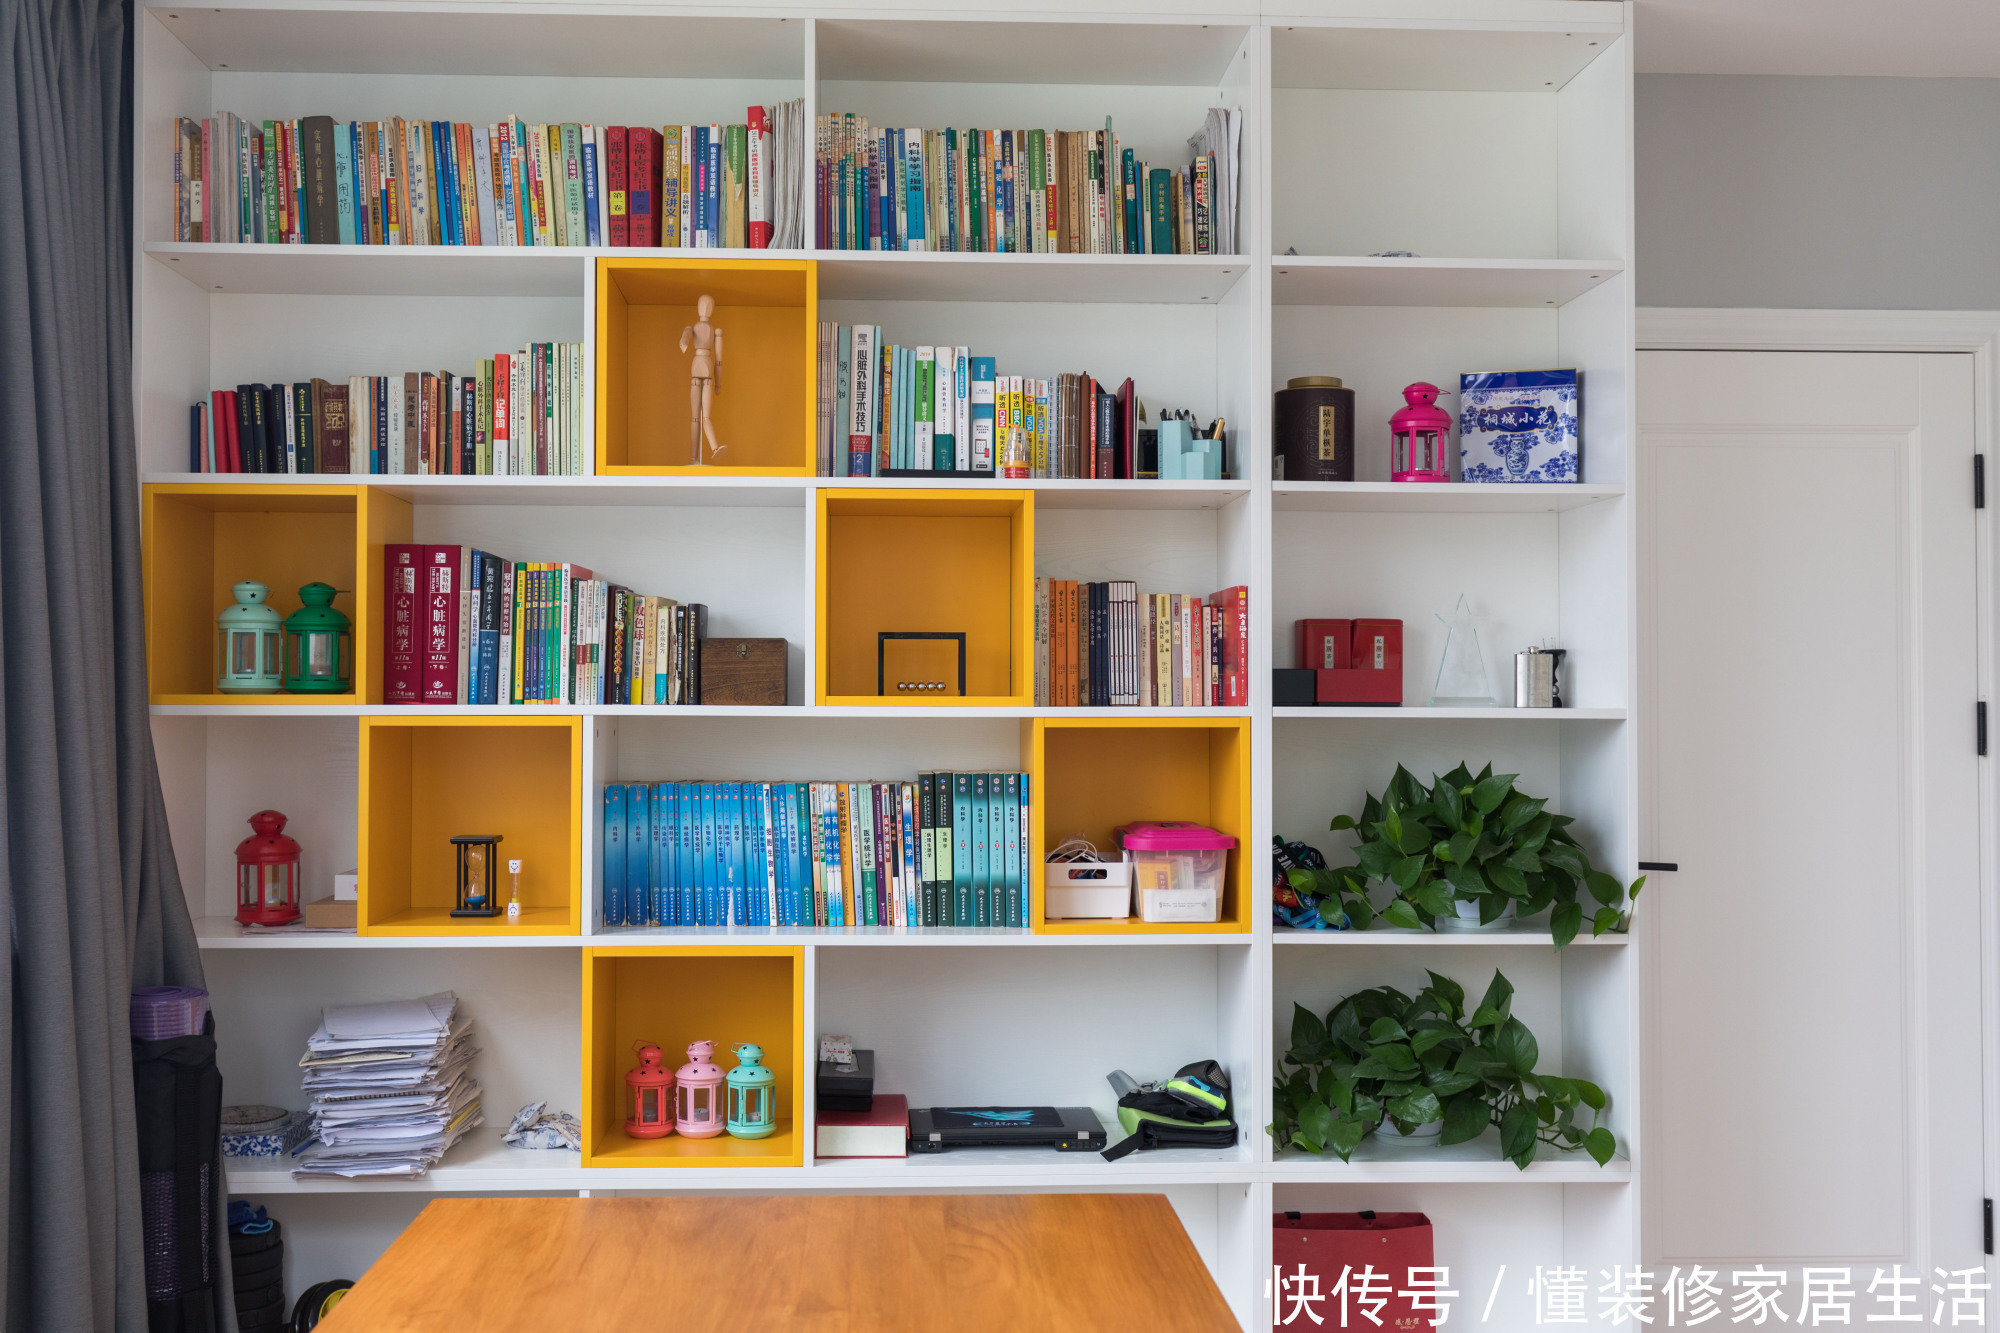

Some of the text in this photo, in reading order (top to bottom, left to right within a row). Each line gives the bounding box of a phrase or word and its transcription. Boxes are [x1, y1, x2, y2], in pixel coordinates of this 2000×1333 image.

[500, 126, 508, 141] 2012
[566, 129, 578, 180] 国家执业医师 资格考试
[584, 146, 594, 199] 临床医学双语教材
[708, 146, 718, 199] 临床医学双语教材
[868, 140, 879, 190] 外科学学习指南
[908, 142, 922, 192] 内科学学习指南
[665, 178, 678, 218] 辅导讲义
[477, 380, 485, 430] 心脏外科手术札记
[495, 373, 506, 429] 不择手段记单词
[855, 350, 868, 433] 心脏外科手术技巧
[998, 395, 1006, 408] 听透
[1013, 393, 1020, 407] 听透
[1026, 402, 1033, 416] 听透
[407, 396, 416, 429] 思考中医
[465, 393, 474, 450] 赫斯特心脏病学手册
[1037, 405, 1044, 418] 听透
[1483, 409, 1552, 427] 桐城小花
[856, 454, 863, 463] 2
[441, 569, 451, 593] 赫斯特
[396, 595, 410, 651] 心脏病学
[503, 572, 511, 635] 冠心病的诊断与治疗
[633, 606, 645, 640] 双色球
[432, 595, 448, 652] 心脏病学
[1174, 624, 1181, 642] 诗经
[733, 824, 741, 842] 药理学
[838, 798, 848, 834] 放射肿瘤学
[765, 827, 775, 879] 细胞生物学
[789, 824, 797, 855] 系统解剖学
[824, 815, 832, 863] 有机化学
[831, 815, 840, 863] 有机化学
[863, 828, 872, 867] 医学统计学
[904, 822, 912, 858] 生理学
